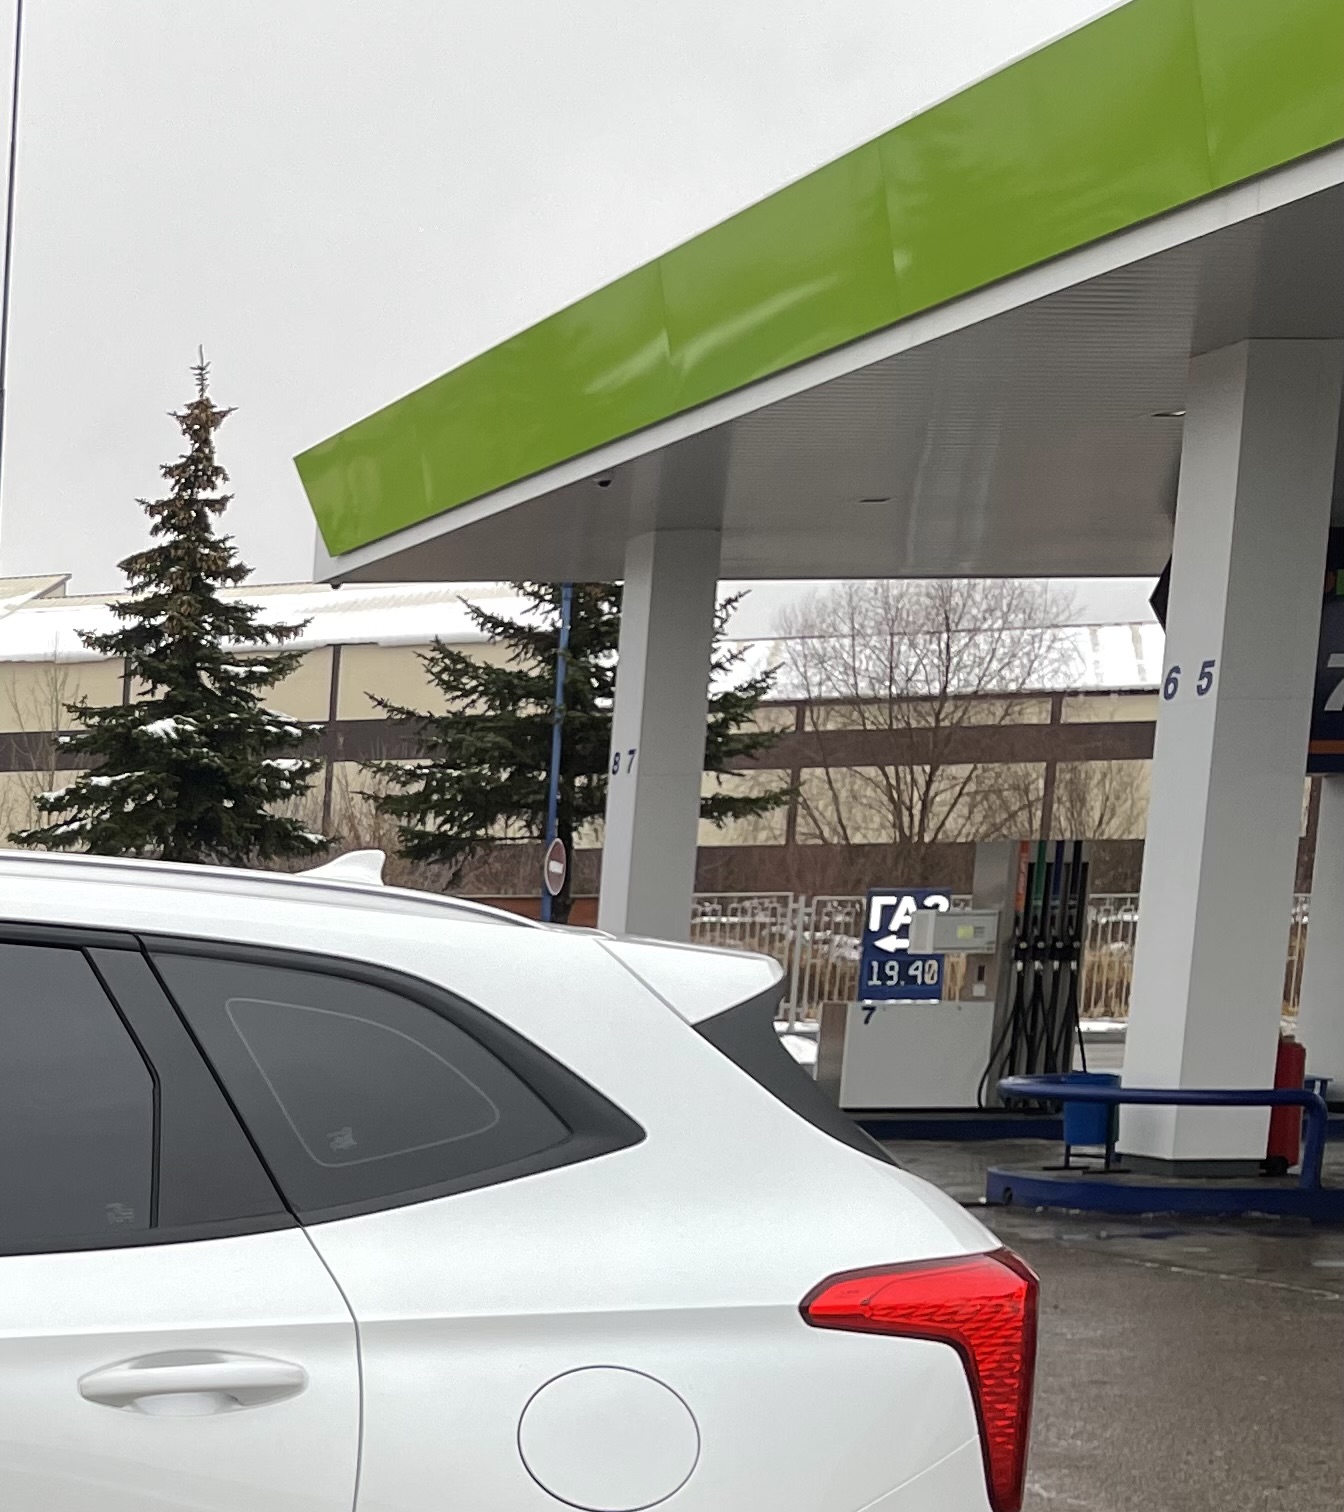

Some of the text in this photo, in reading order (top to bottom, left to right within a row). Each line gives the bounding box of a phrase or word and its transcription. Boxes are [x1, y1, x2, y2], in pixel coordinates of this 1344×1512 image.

[1163, 660, 1216, 700] 6 5
[612, 748, 636, 775] 8 7
[867, 959, 938, 986] 19.40
[862, 1006, 876, 1025] 7
